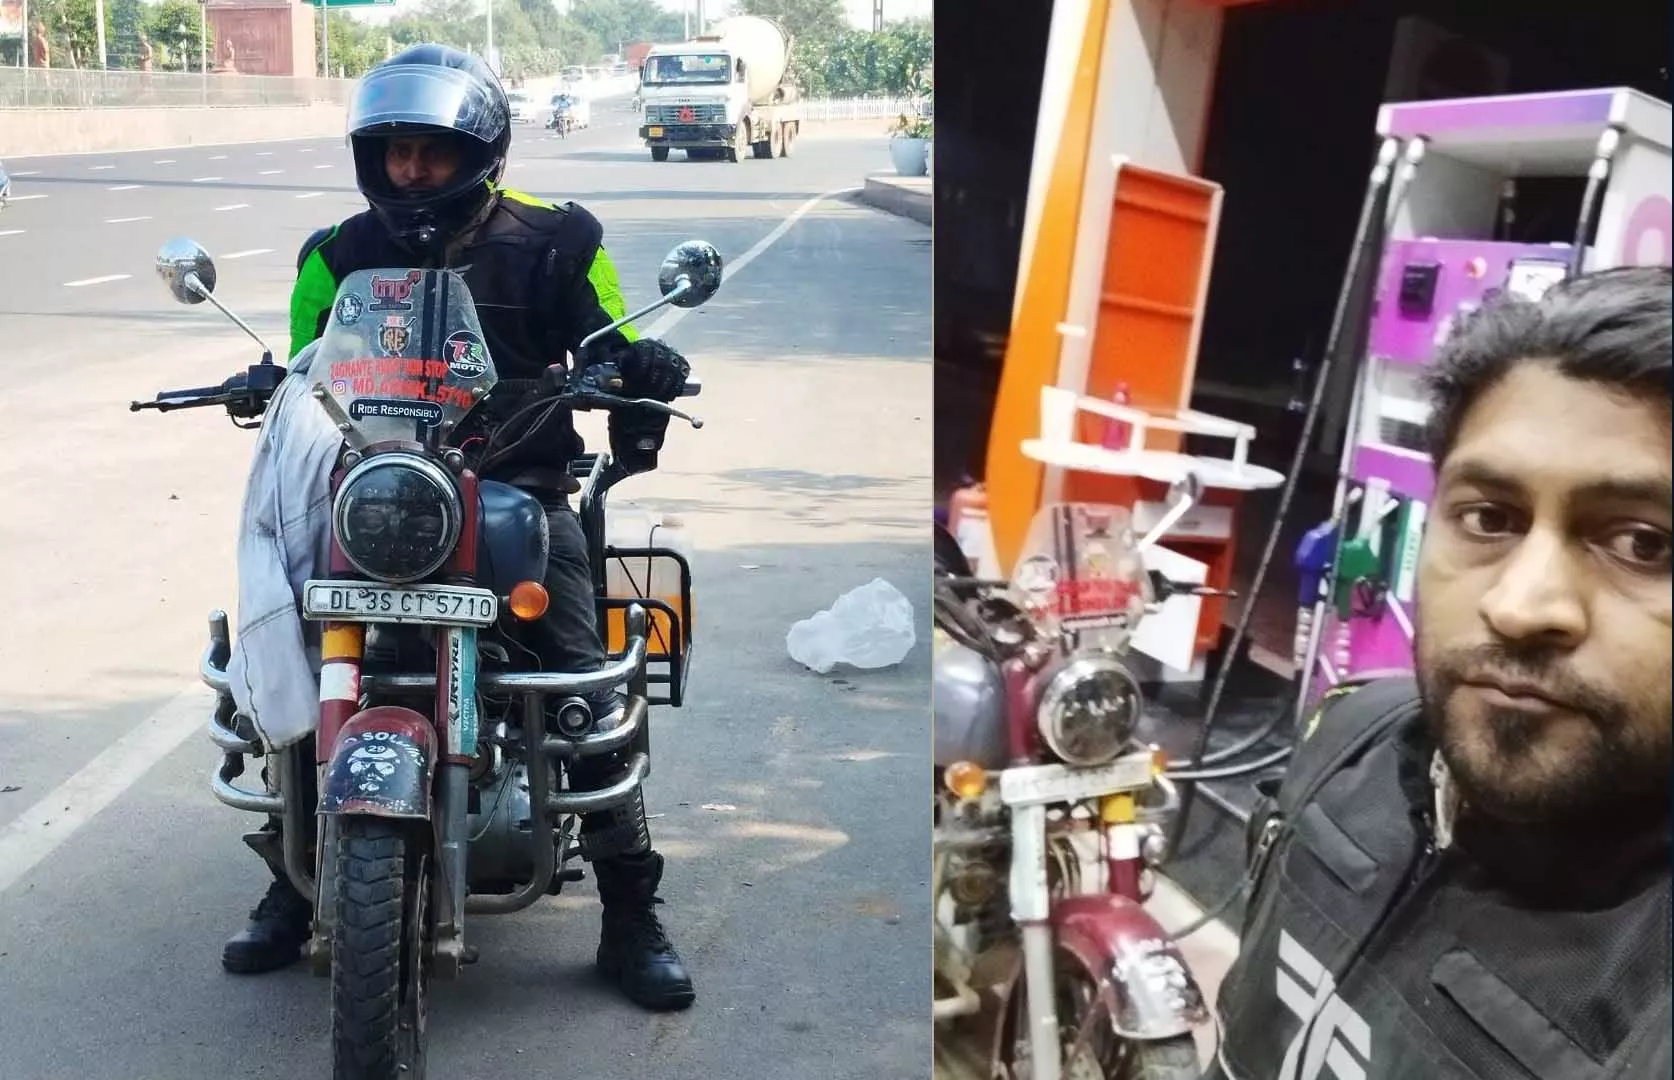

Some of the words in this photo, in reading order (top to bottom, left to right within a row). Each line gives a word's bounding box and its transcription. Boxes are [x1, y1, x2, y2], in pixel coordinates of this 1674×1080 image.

[449, 361, 485, 372] MOTO
[352, 404, 356, 414] I
[358, 404, 378, 415] RIDE
[381, 405, 440, 419] RESPONSIBLY
[331, 590, 356, 610] DL
[366, 592, 392, 611] 3S
[401, 593, 428, 614] CT
[437, 595, 491, 617] 5710
